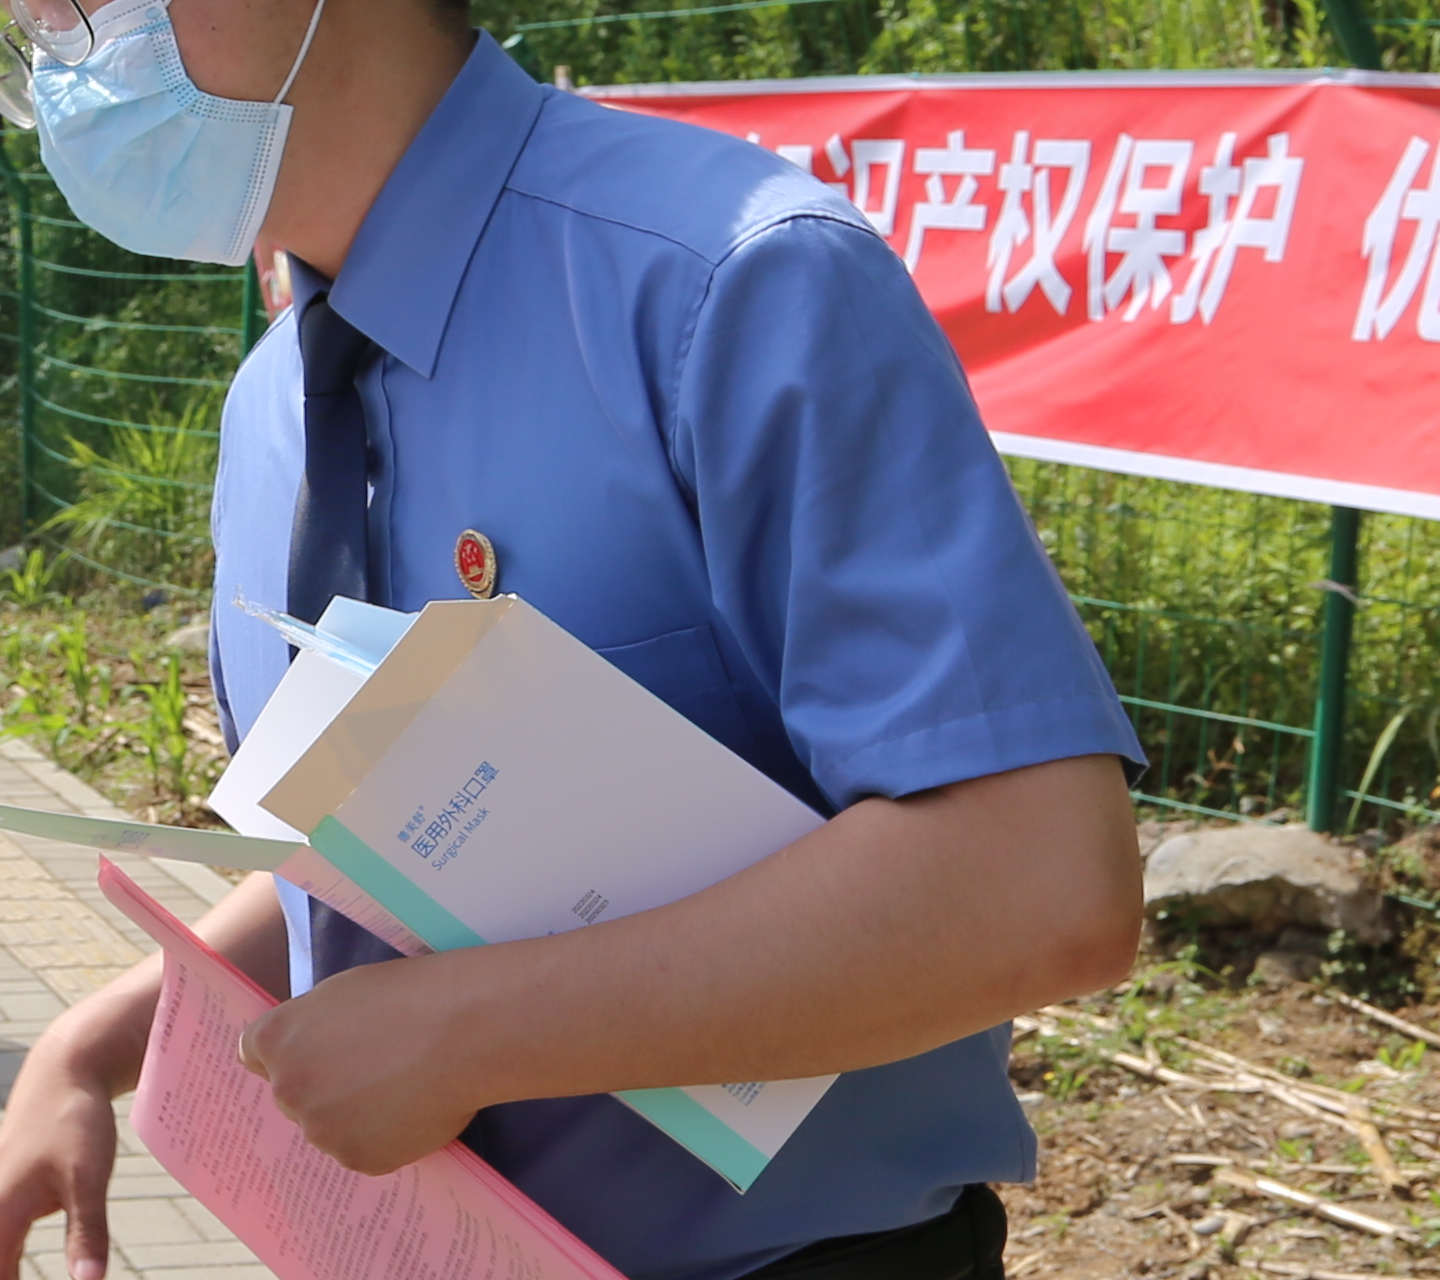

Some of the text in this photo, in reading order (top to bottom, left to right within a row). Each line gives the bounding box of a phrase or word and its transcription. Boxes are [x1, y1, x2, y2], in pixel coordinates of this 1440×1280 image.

[411, 760, 500, 859] 医用外科口罩
[431, 807, 490, 871] Surgical Mask
